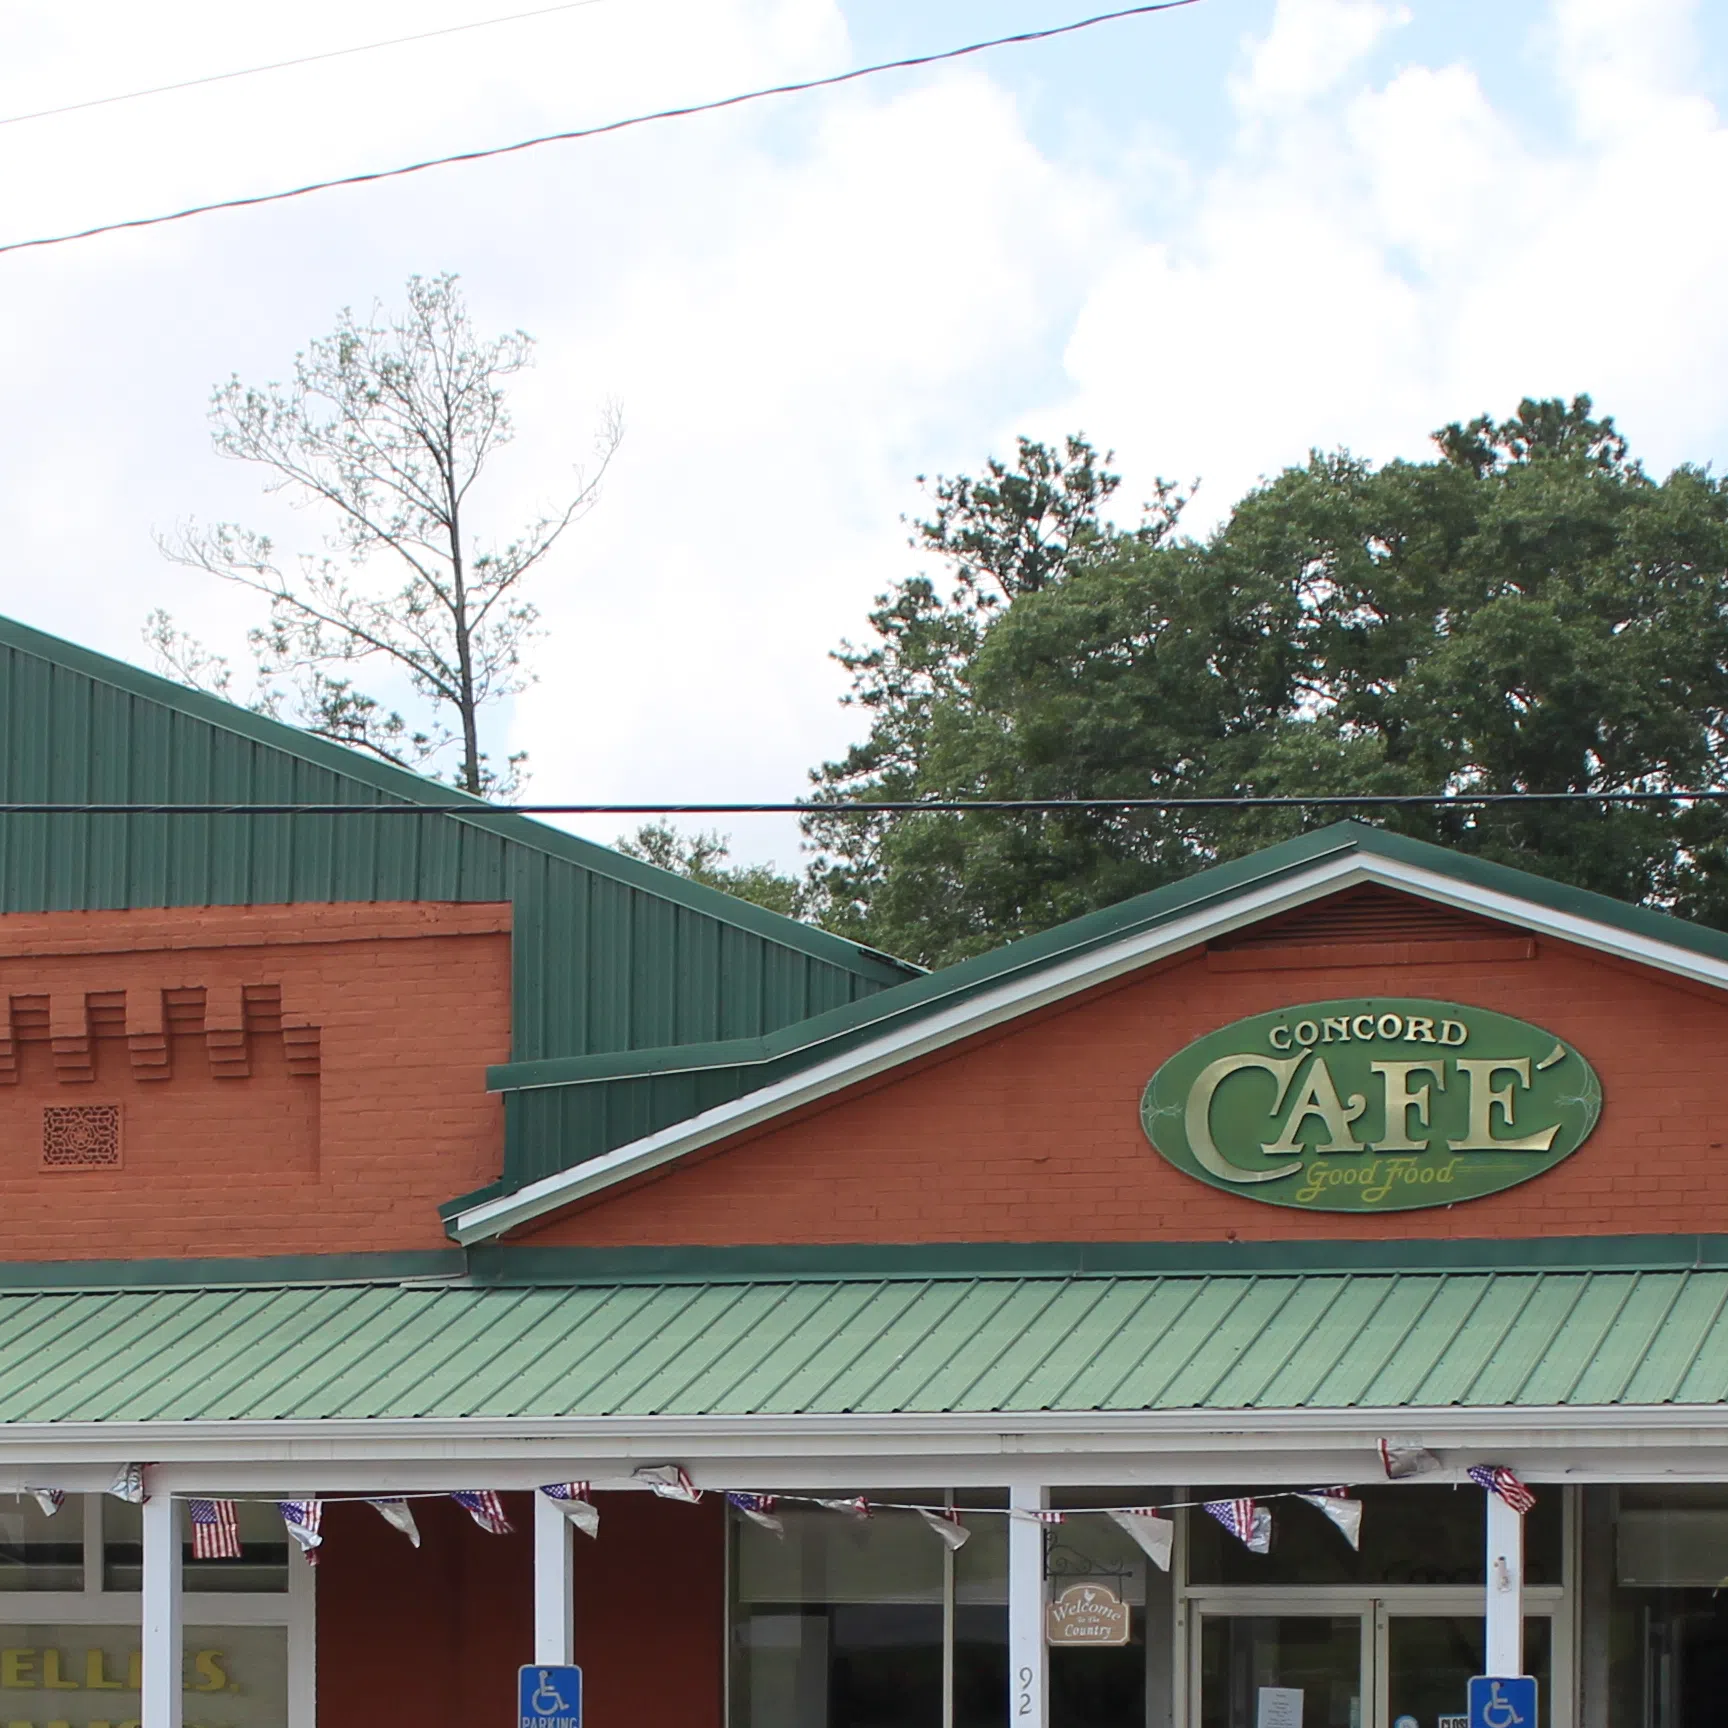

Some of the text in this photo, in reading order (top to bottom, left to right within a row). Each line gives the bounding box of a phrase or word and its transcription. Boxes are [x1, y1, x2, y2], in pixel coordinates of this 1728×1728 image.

[1269, 1012, 1469, 1051] CONCORD
[1295, 1157, 1459, 1202] Good Food
[1053, 1599, 1121, 1623] Welcome
[1065, 1624, 1112, 1639] Country
[1018, 1666, 1034, 1717] 92
